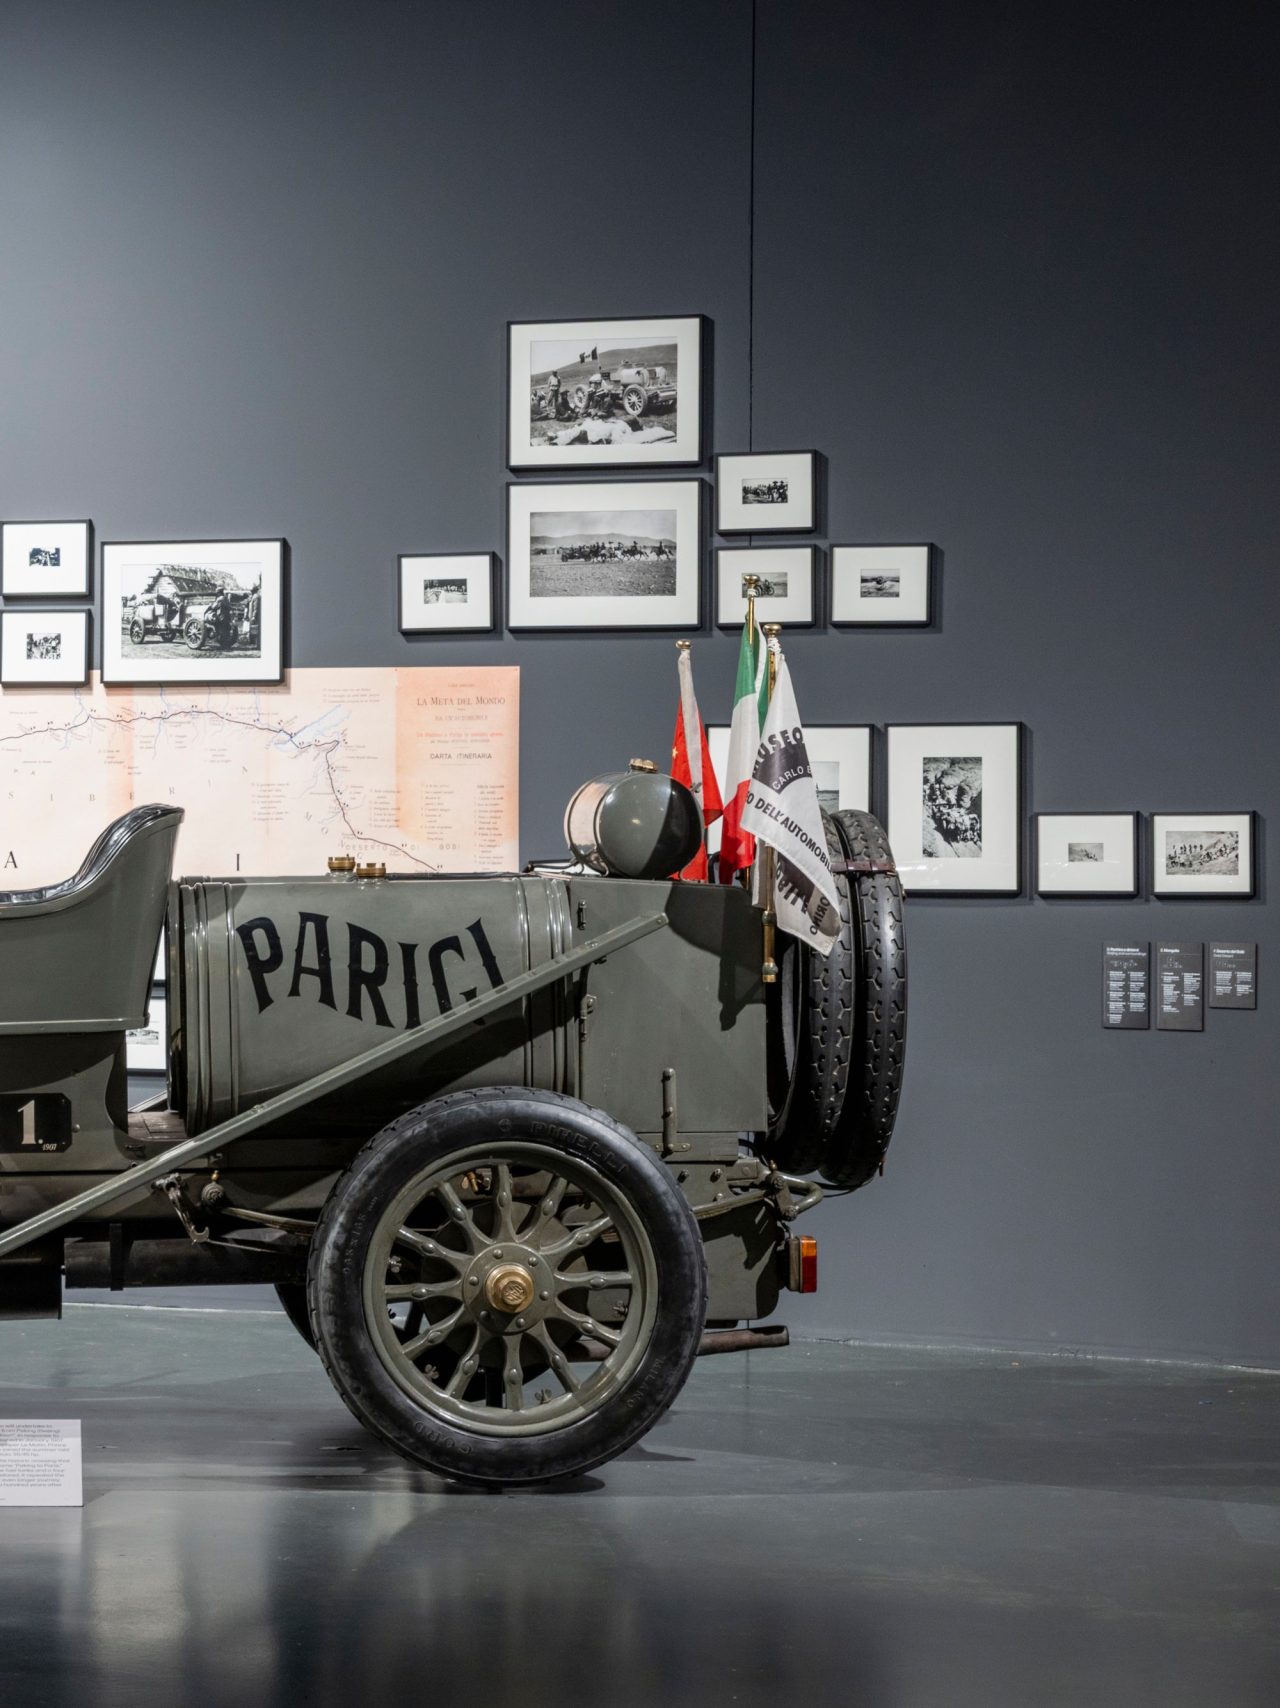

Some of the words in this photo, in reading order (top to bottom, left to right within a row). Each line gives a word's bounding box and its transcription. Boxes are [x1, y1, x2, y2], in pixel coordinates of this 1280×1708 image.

[417, 698, 428, 706] LA
[430, 696, 455, 706] META
[457, 698, 473, 706] DEL
[476, 696, 506, 705] MONDO
[456, 752, 492, 760] ITINERARIA
[772, 765, 805, 791] CARLO
[235, 911, 507, 1029] PARIGI
[42, 1143, 58, 1151] 1907
[530, 1121, 630, 1174] PIRELLI
